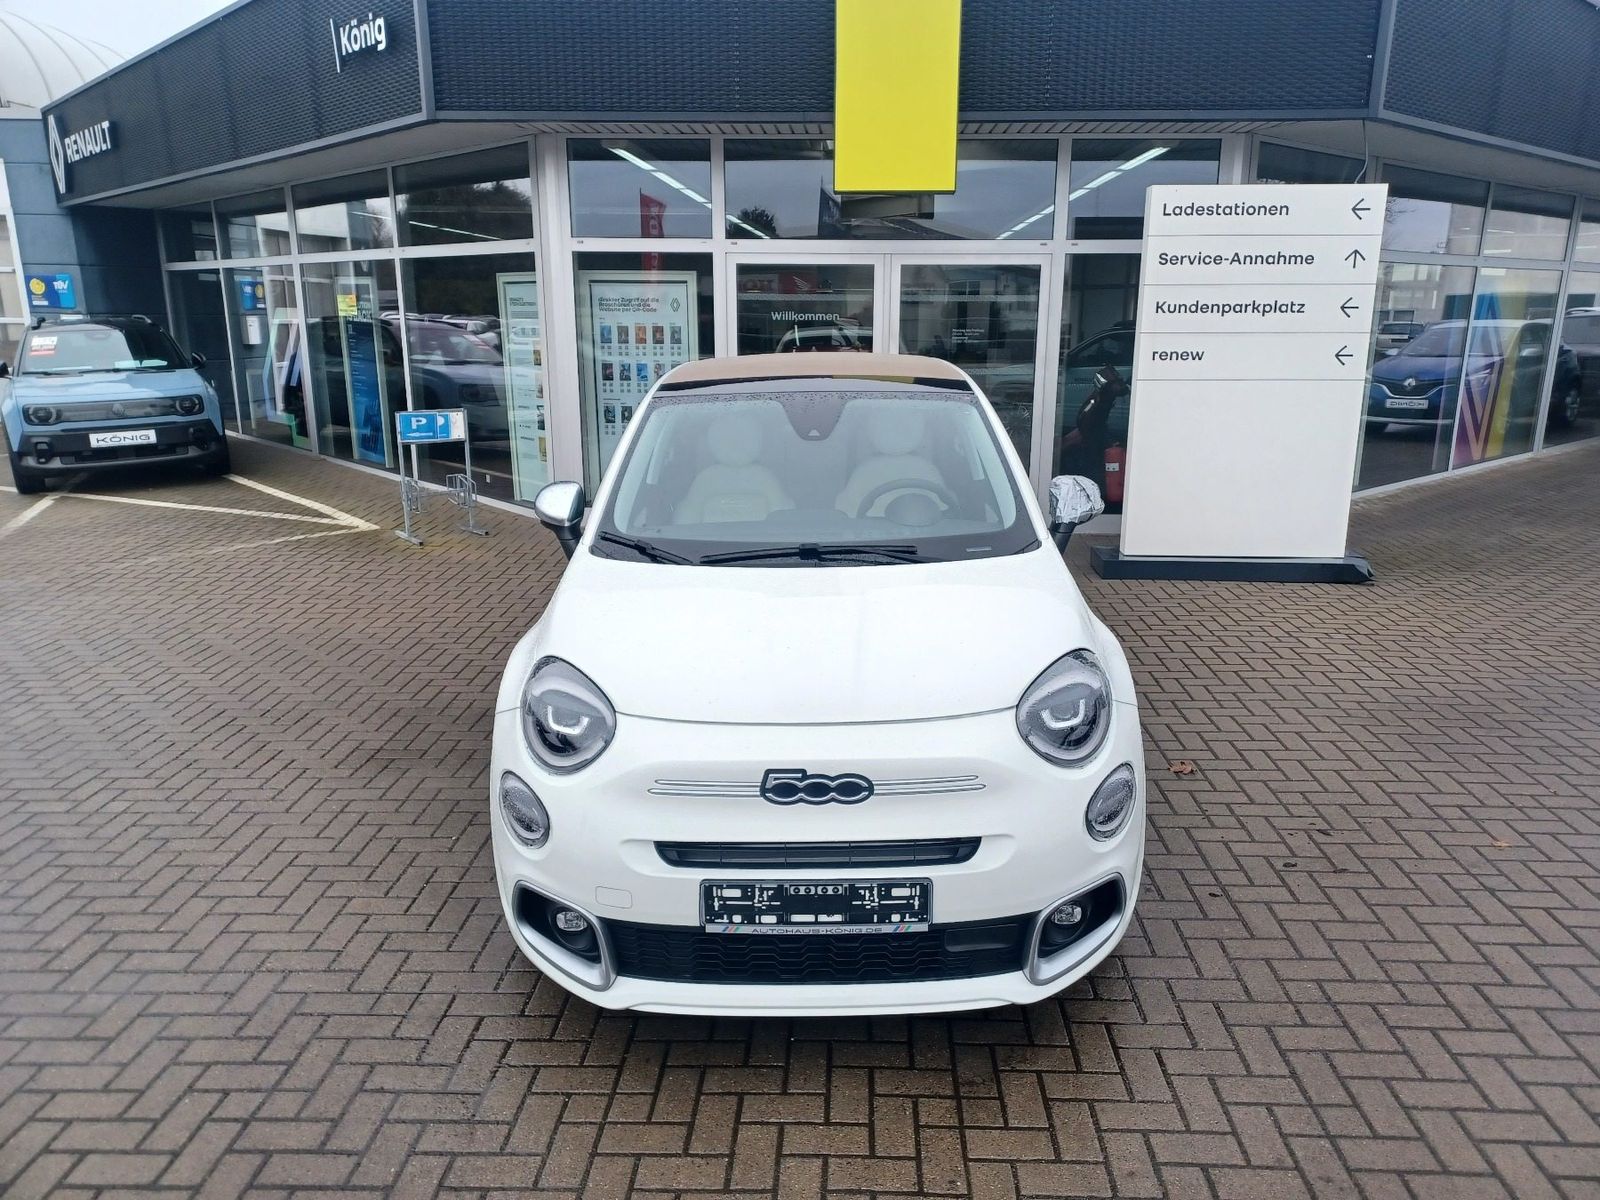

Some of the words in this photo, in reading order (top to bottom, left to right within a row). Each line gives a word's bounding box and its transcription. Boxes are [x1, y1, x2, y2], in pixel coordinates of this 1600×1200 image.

[340, 12, 386, 55] König
[64, 120, 111, 164] RENAULT
[1162, 202, 1290, 217] Ladestationen
[1158, 251, 1315, 266] Service-Annahme
[771, 311, 841, 321] Willkommen
[1155, 300, 1306, 317] Kundenparkplatz
[1152, 350, 1205, 361] renew
[411, 416, 427, 430] P
[96, 433, 151, 444] KÖNIG
[760, 769, 874, 805] 500
